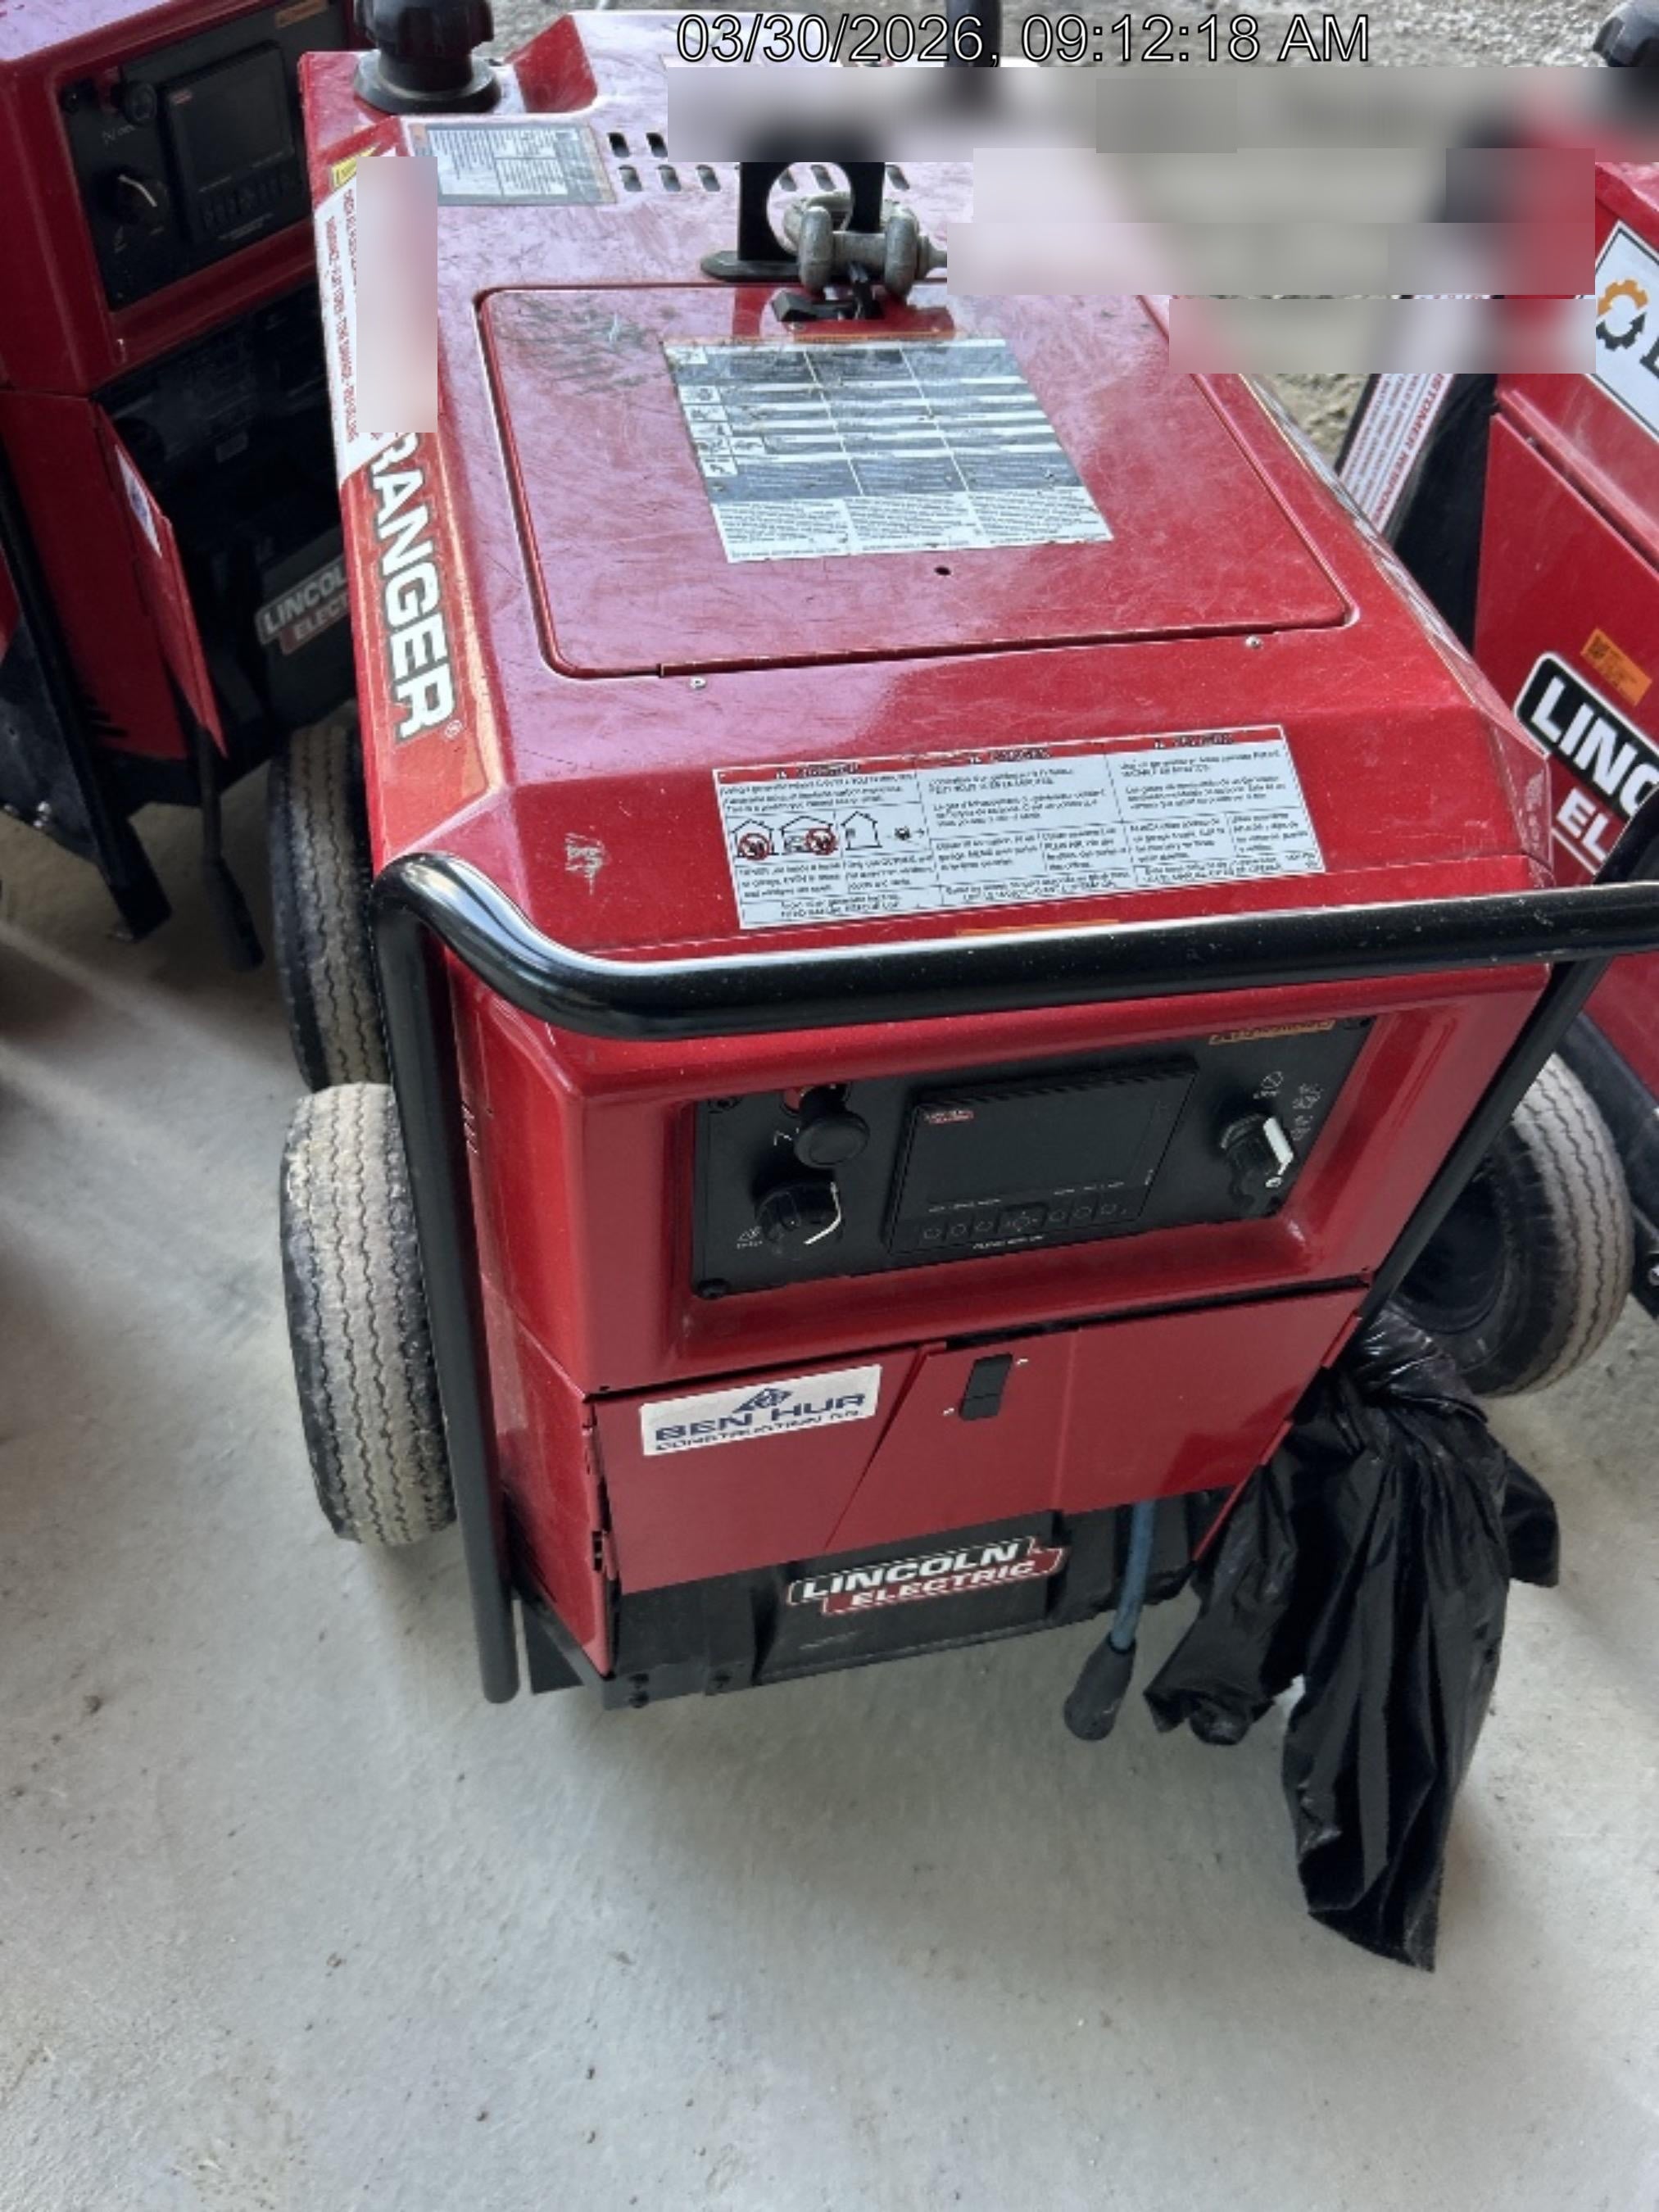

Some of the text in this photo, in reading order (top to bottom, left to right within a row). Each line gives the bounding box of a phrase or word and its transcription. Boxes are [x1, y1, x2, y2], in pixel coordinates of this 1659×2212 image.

[655, 1393, 865, 1441] BEN HUR
[802, 1543, 1020, 1598] LINCOLN
[851, 1560, 1036, 1607] ELECTRIC
